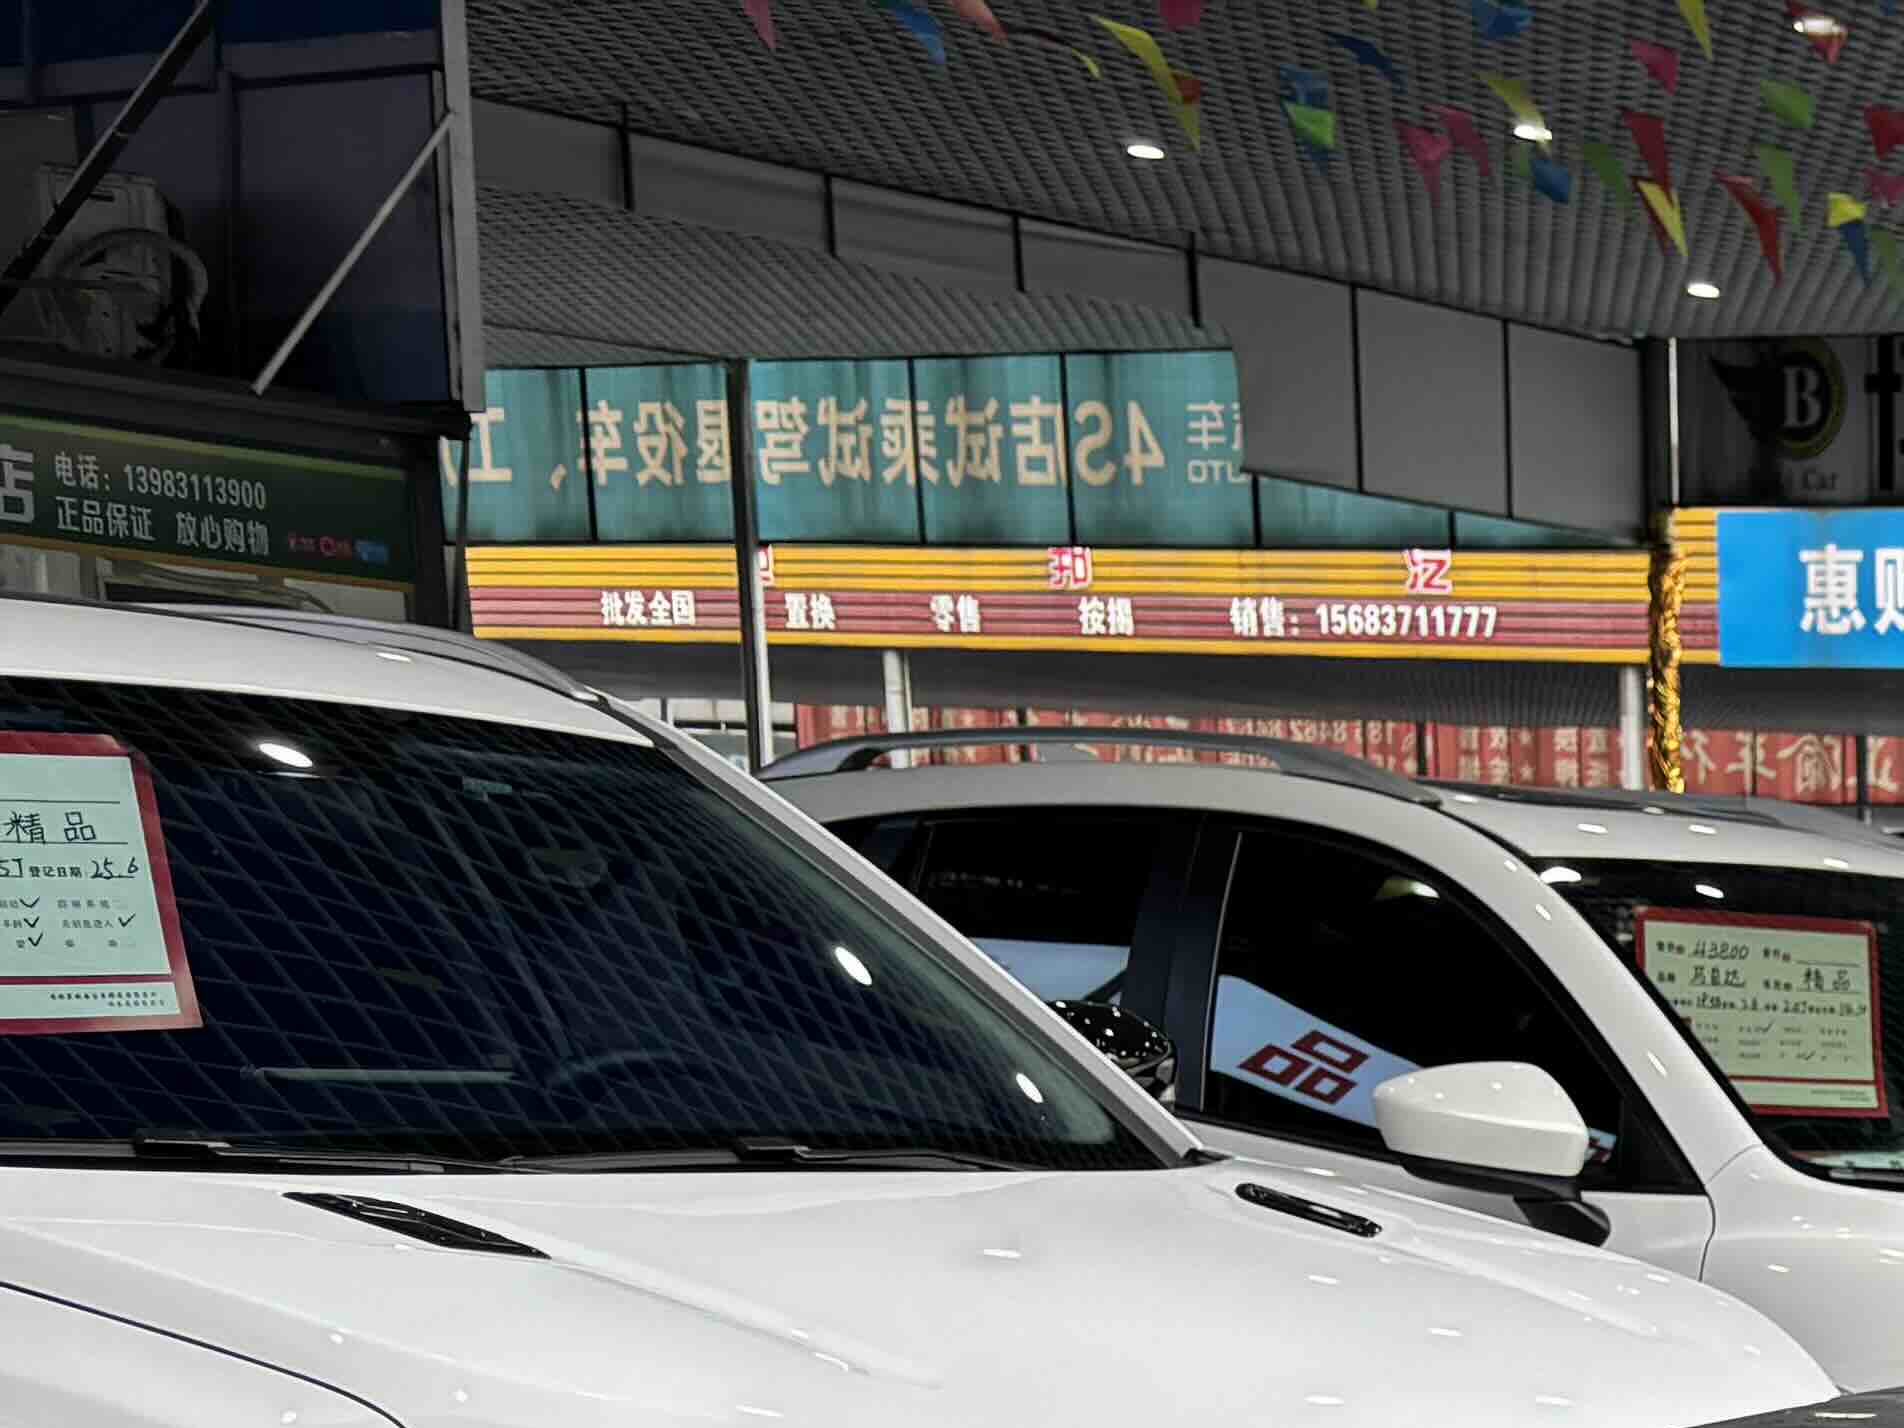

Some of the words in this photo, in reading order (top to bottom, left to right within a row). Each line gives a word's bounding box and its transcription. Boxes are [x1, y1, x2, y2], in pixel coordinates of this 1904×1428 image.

[56, 495, 156, 542] 正品保证
[175, 510, 271, 556] 放心购物
[601, 589, 696, 627] 批发全国
[785, 592, 837, 631] 置换
[930, 594, 981, 633] 零售
[1078, 596, 1136, 637] 按揭
[3, 810, 97, 845] 精品
